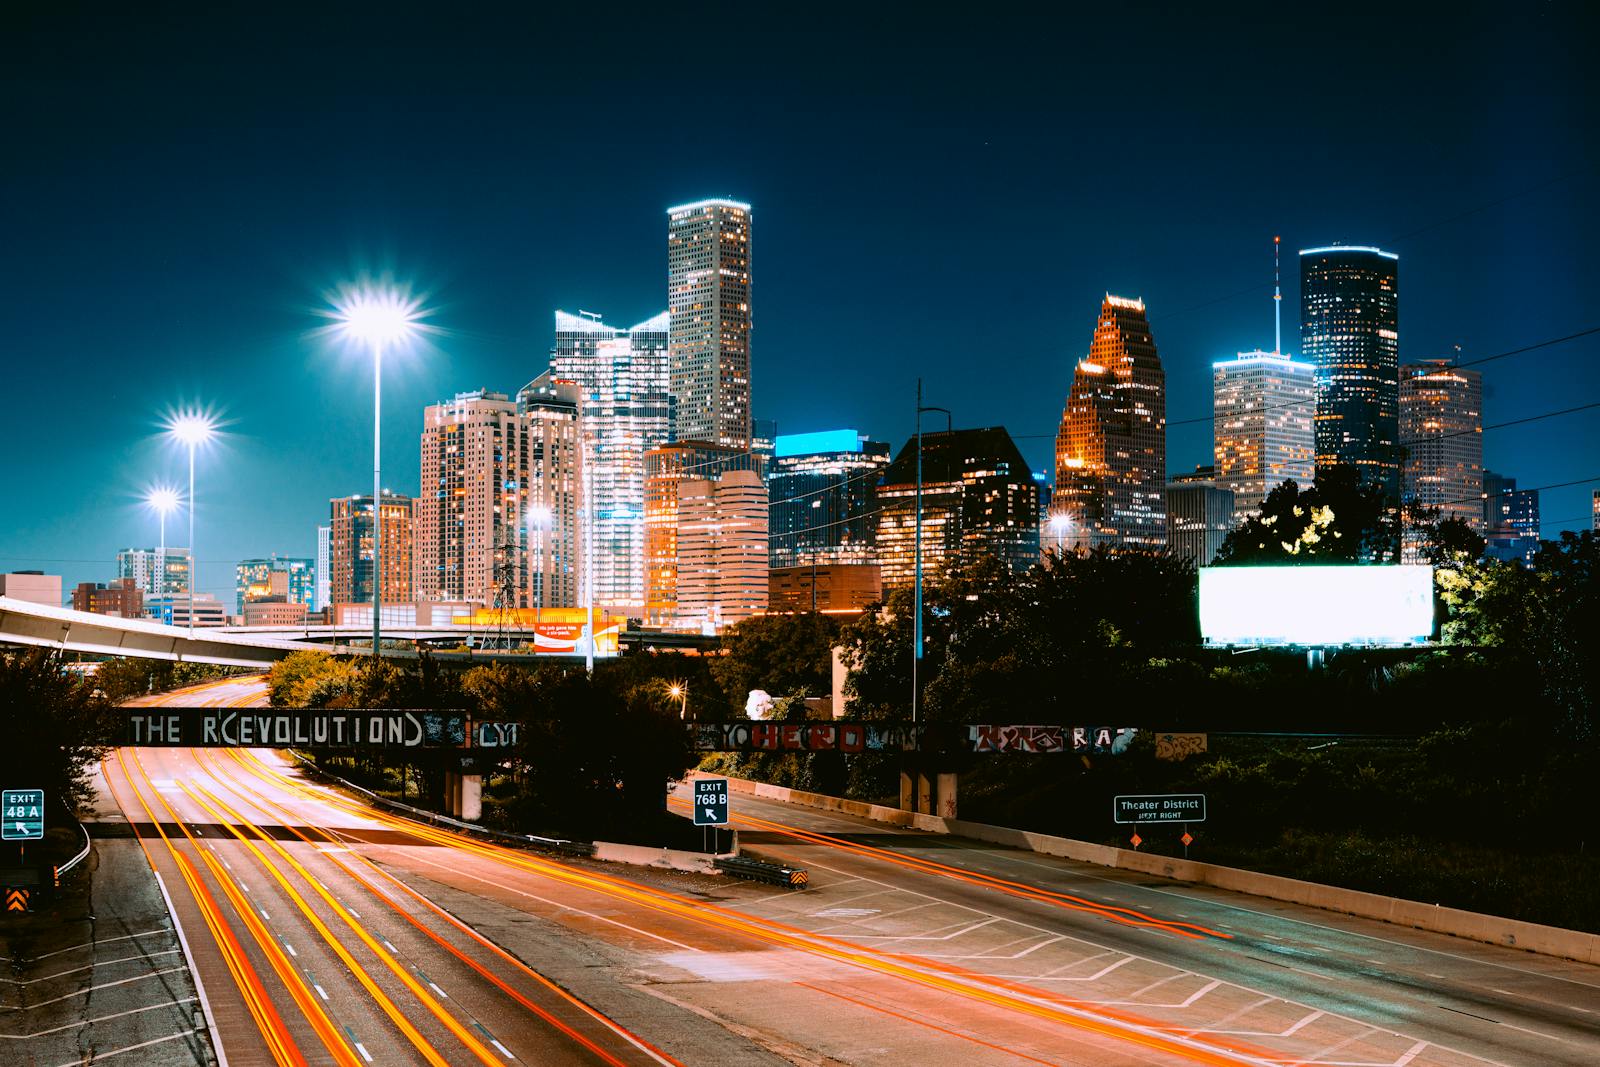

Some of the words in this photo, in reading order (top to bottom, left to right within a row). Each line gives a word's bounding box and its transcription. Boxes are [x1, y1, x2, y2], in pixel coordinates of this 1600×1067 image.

[131, 716, 180, 742] THE
[700, 783, 722, 791] EXIT
[10, 794, 36, 803] EXIT
[695, 794, 717, 805] 768
[719, 793, 727, 805] B
[1121, 800, 1160, 810] Theater
[1163, 799, 1199, 809] District
[6, 806, 26, 818] 48
[28, 805, 39, 818] A
[1159, 811, 1182, 820] RIGHT
